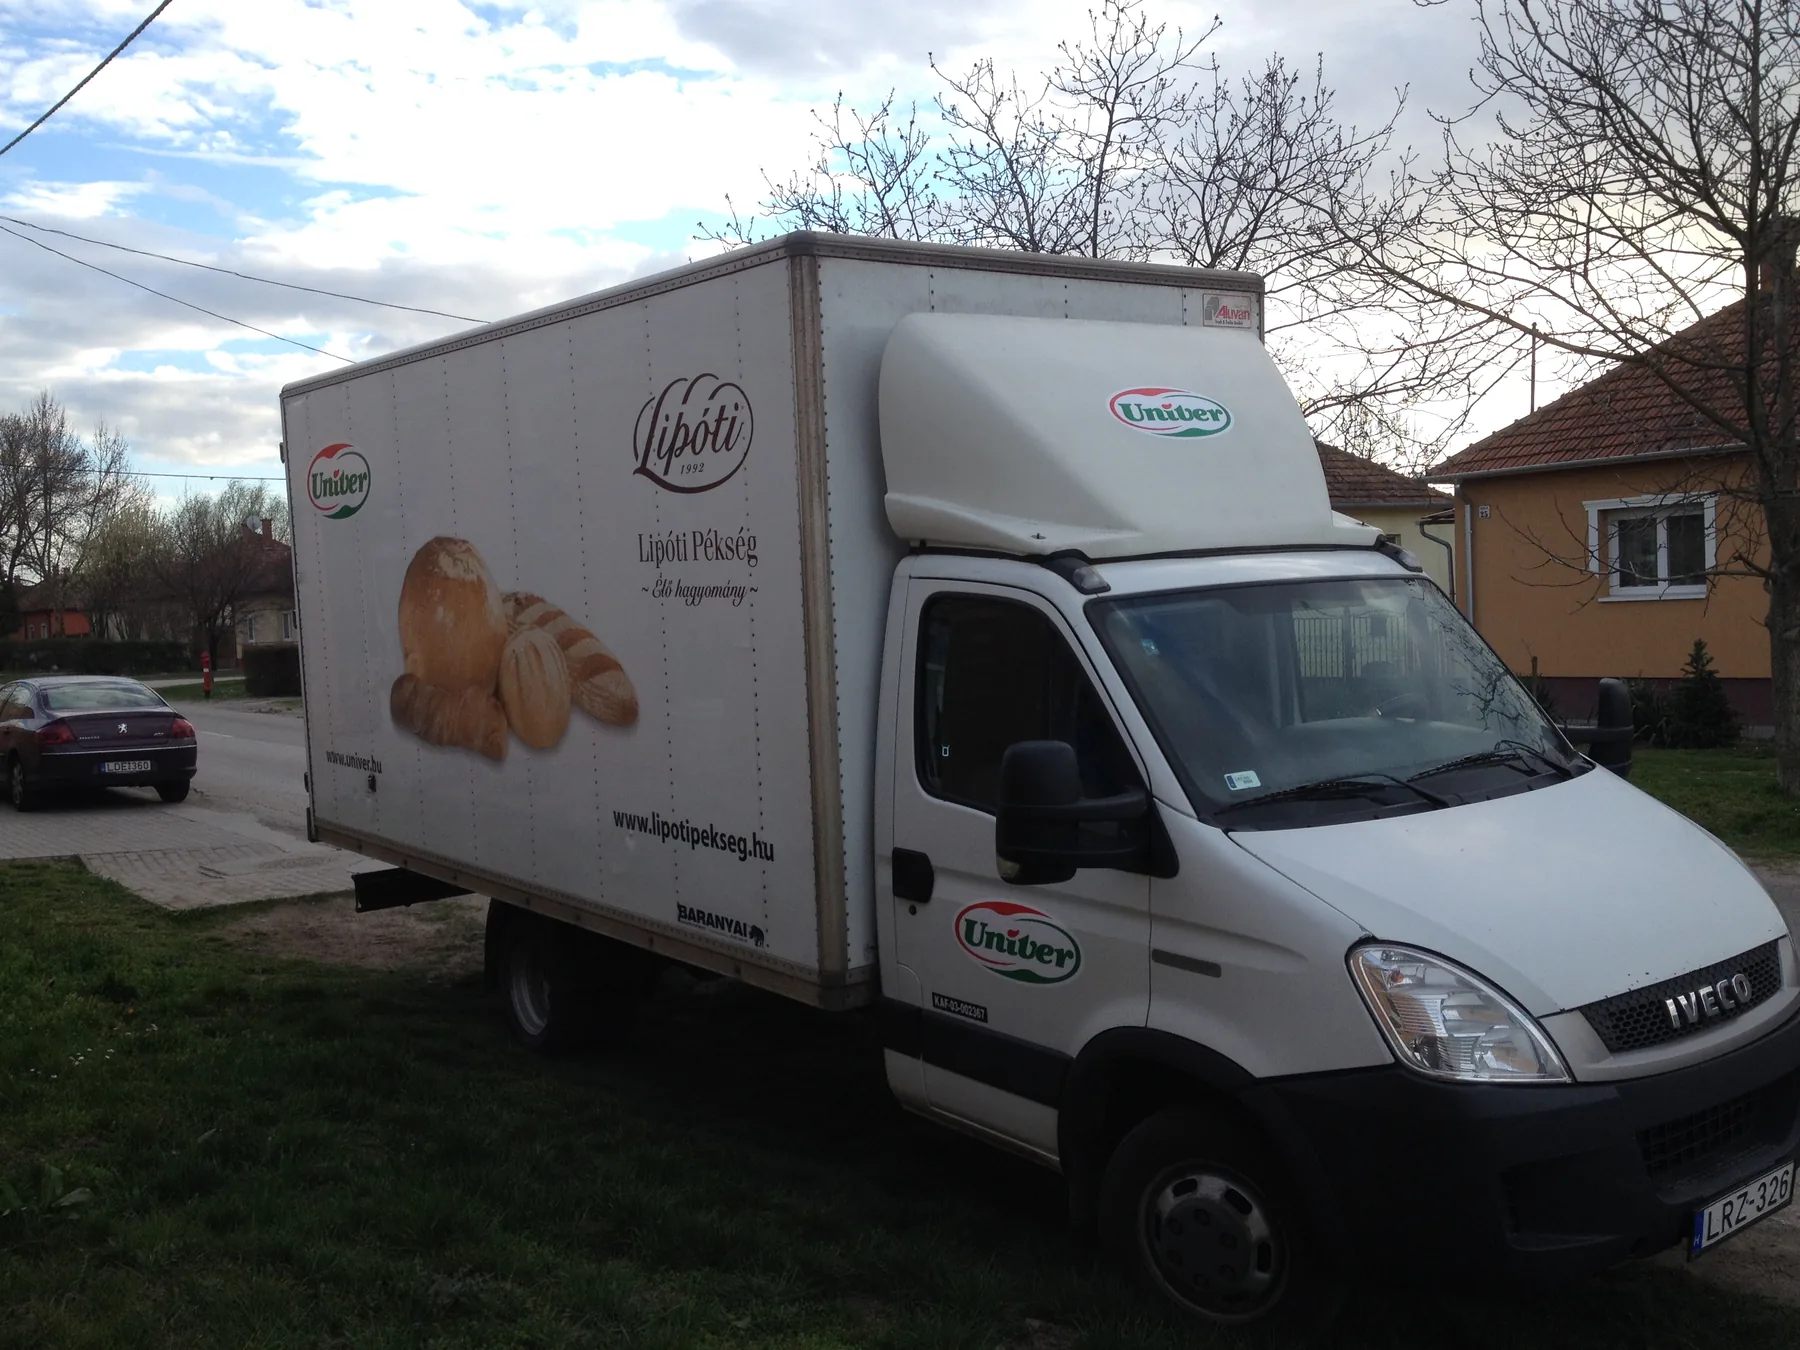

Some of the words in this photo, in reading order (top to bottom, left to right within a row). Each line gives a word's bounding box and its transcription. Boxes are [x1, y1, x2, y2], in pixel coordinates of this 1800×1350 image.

[1215, 305, 1250, 321] Aluvan
[633, 377, 746, 480] Lipóti
[1118, 403, 1224, 423] Univer
[311, 469, 368, 500] Univer
[680, 462, 705, 475] 1992
[638, 530, 688, 569] Lipóti
[692, 526, 758, 568] Pékség
[675, 579, 747, 608] hagyomány
[325, 750, 383, 774] www.univer.hu
[613, 810, 775, 862] www.lipotipekseg.hu
[677, 902, 748, 938] BARANYAI
[964, 918, 1075, 968] Univer
[1665, 973, 1752, 1029] IVECO
[1706, 1169, 1790, 1242] LRZ-326
